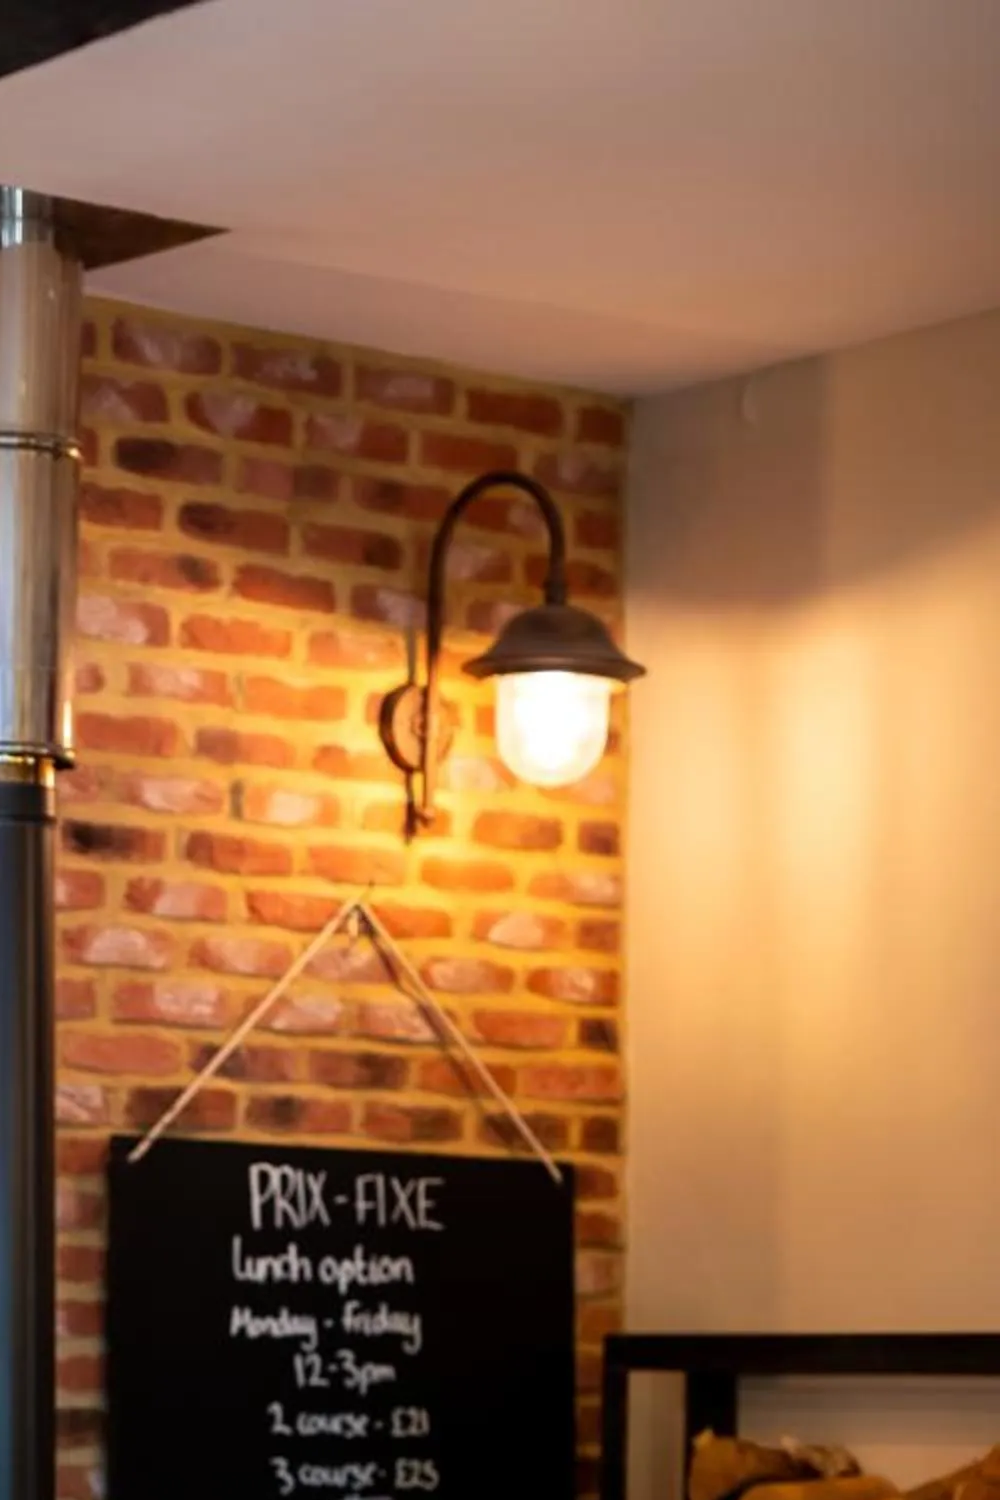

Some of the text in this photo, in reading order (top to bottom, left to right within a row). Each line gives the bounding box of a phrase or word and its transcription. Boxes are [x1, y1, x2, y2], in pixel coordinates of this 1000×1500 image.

[248, 1161, 445, 1230] PRIX-FIXE
[318, 1244, 414, 1295] option
[229, 1305, 318, 1353] Monday
[267, 1401, 293, 1436] 2
[296, 1412, 369, 1439] course
[270, 1456, 296, 1496] 3
[297, 1462, 377, 1491] course
[394, 1457, 440, 1491] £25
